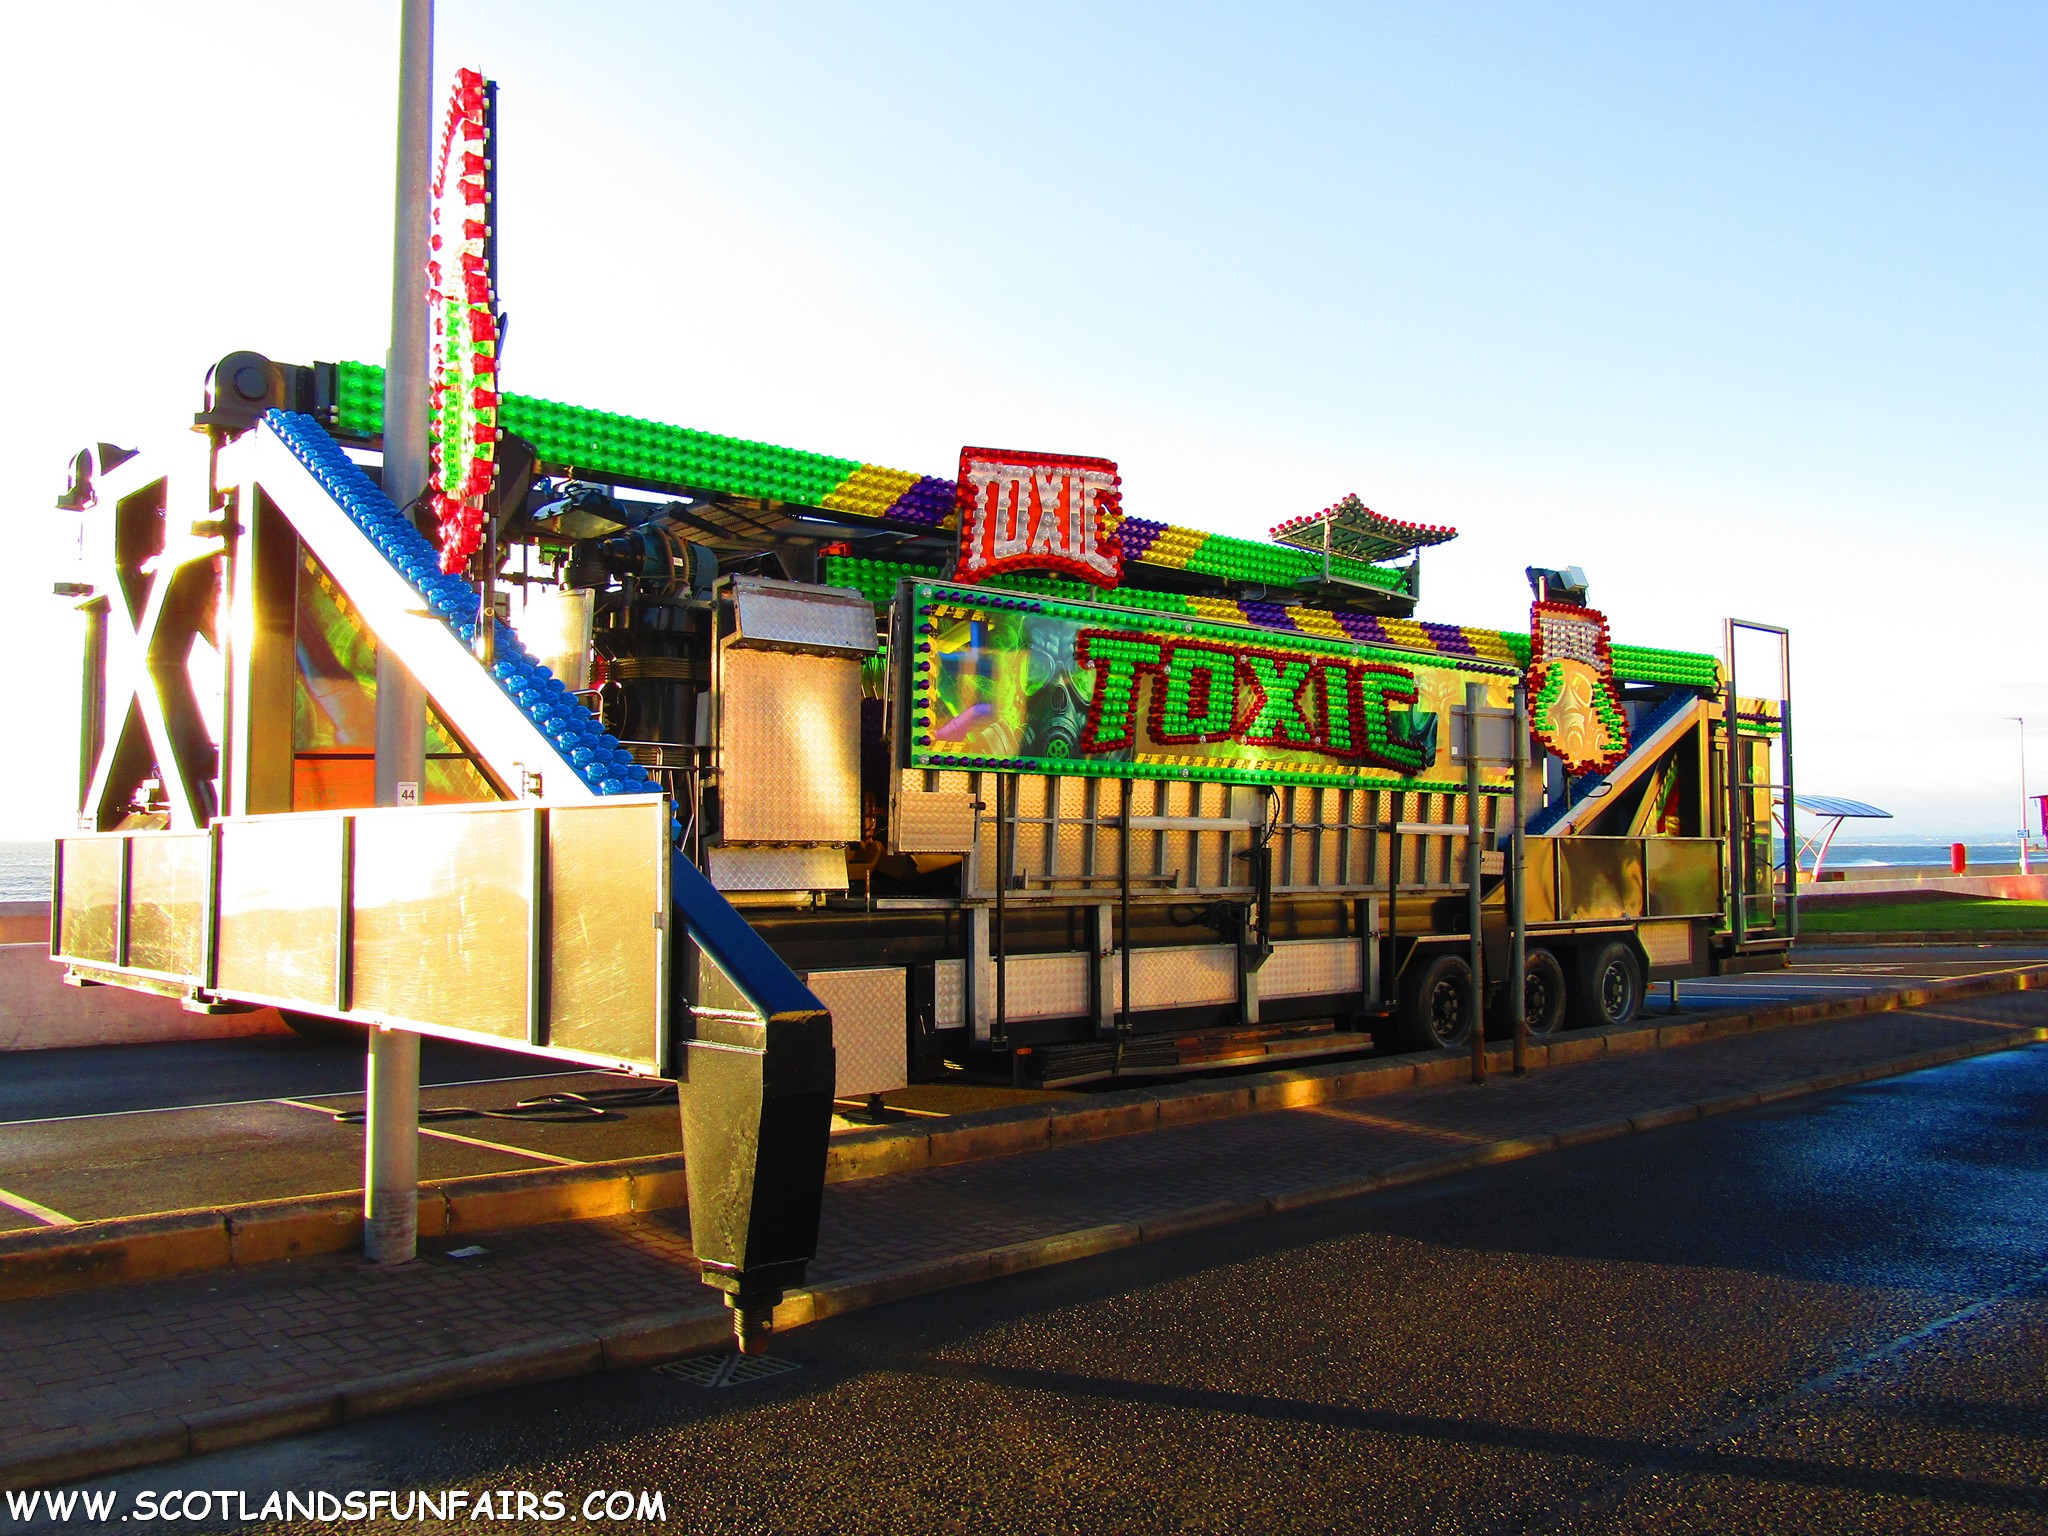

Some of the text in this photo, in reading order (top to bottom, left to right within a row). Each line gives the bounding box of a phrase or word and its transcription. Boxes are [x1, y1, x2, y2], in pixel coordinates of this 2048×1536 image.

[967, 460, 1118, 578] TOXIC
[1077, 628, 1427, 775] TOXIC
[401, 789, 415, 800] 44
